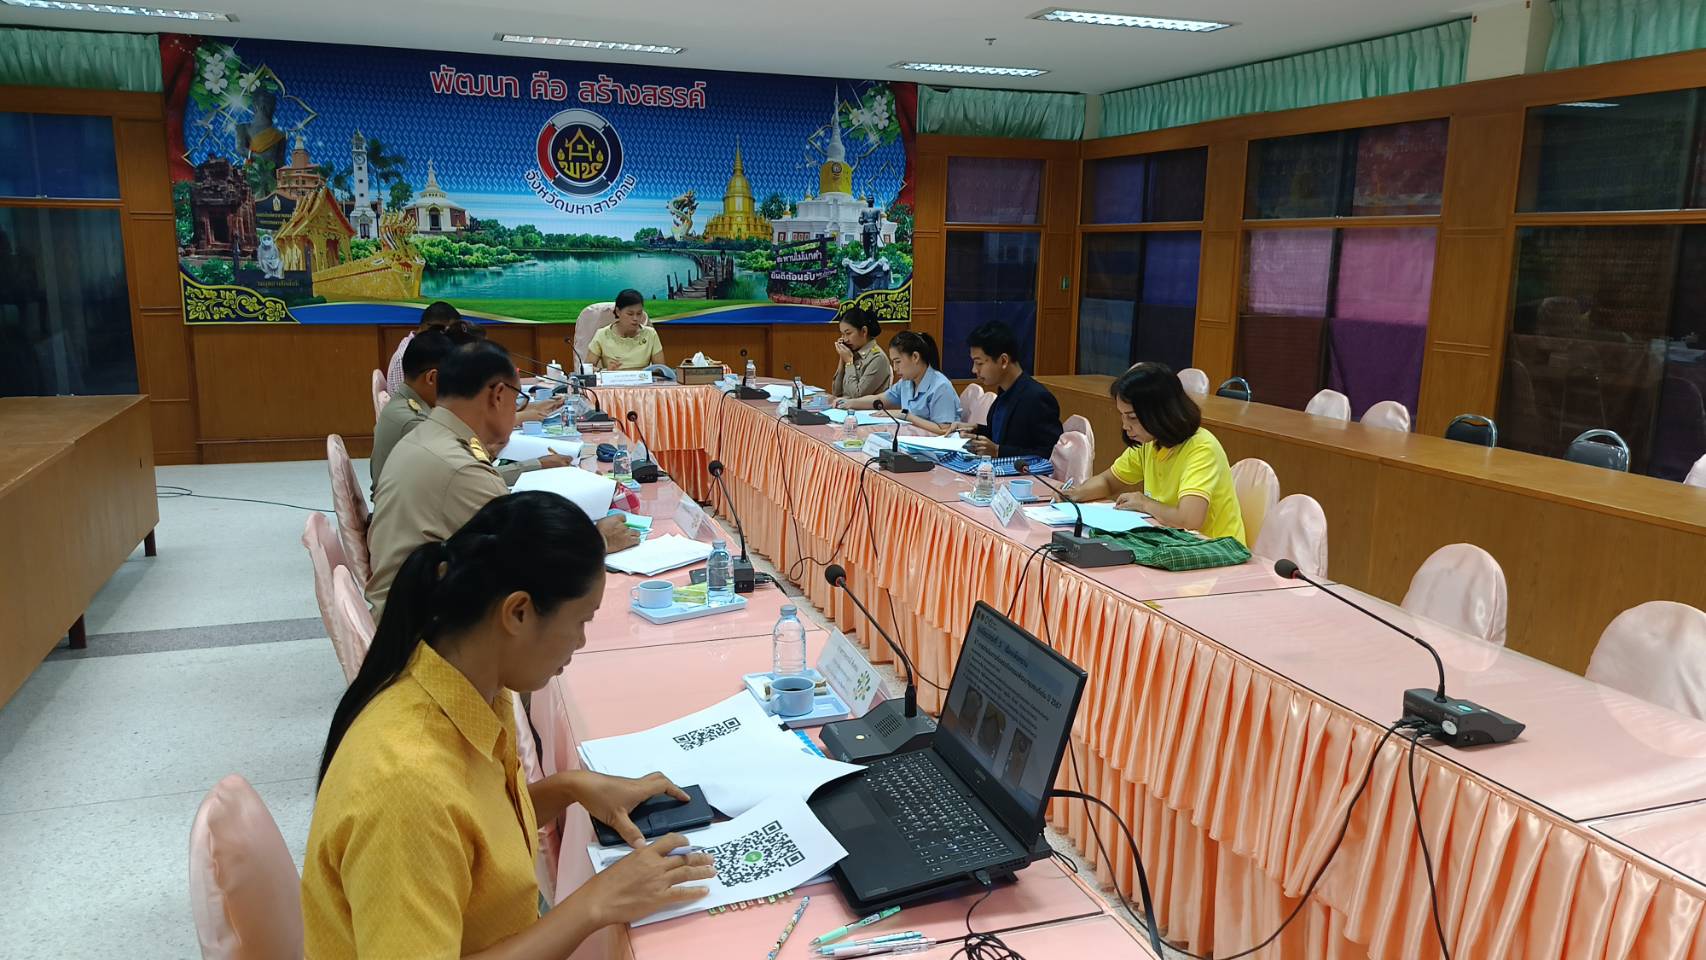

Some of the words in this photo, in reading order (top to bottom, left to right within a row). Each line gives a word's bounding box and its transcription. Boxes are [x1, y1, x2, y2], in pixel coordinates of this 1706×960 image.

[430, 64, 519, 99] พัฒนา
[530, 71, 568, 101] คือ
[578, 74, 707, 109] สร้างสรรค์
[524, 168, 637, 216] จังหวัดมหาสารคาม
